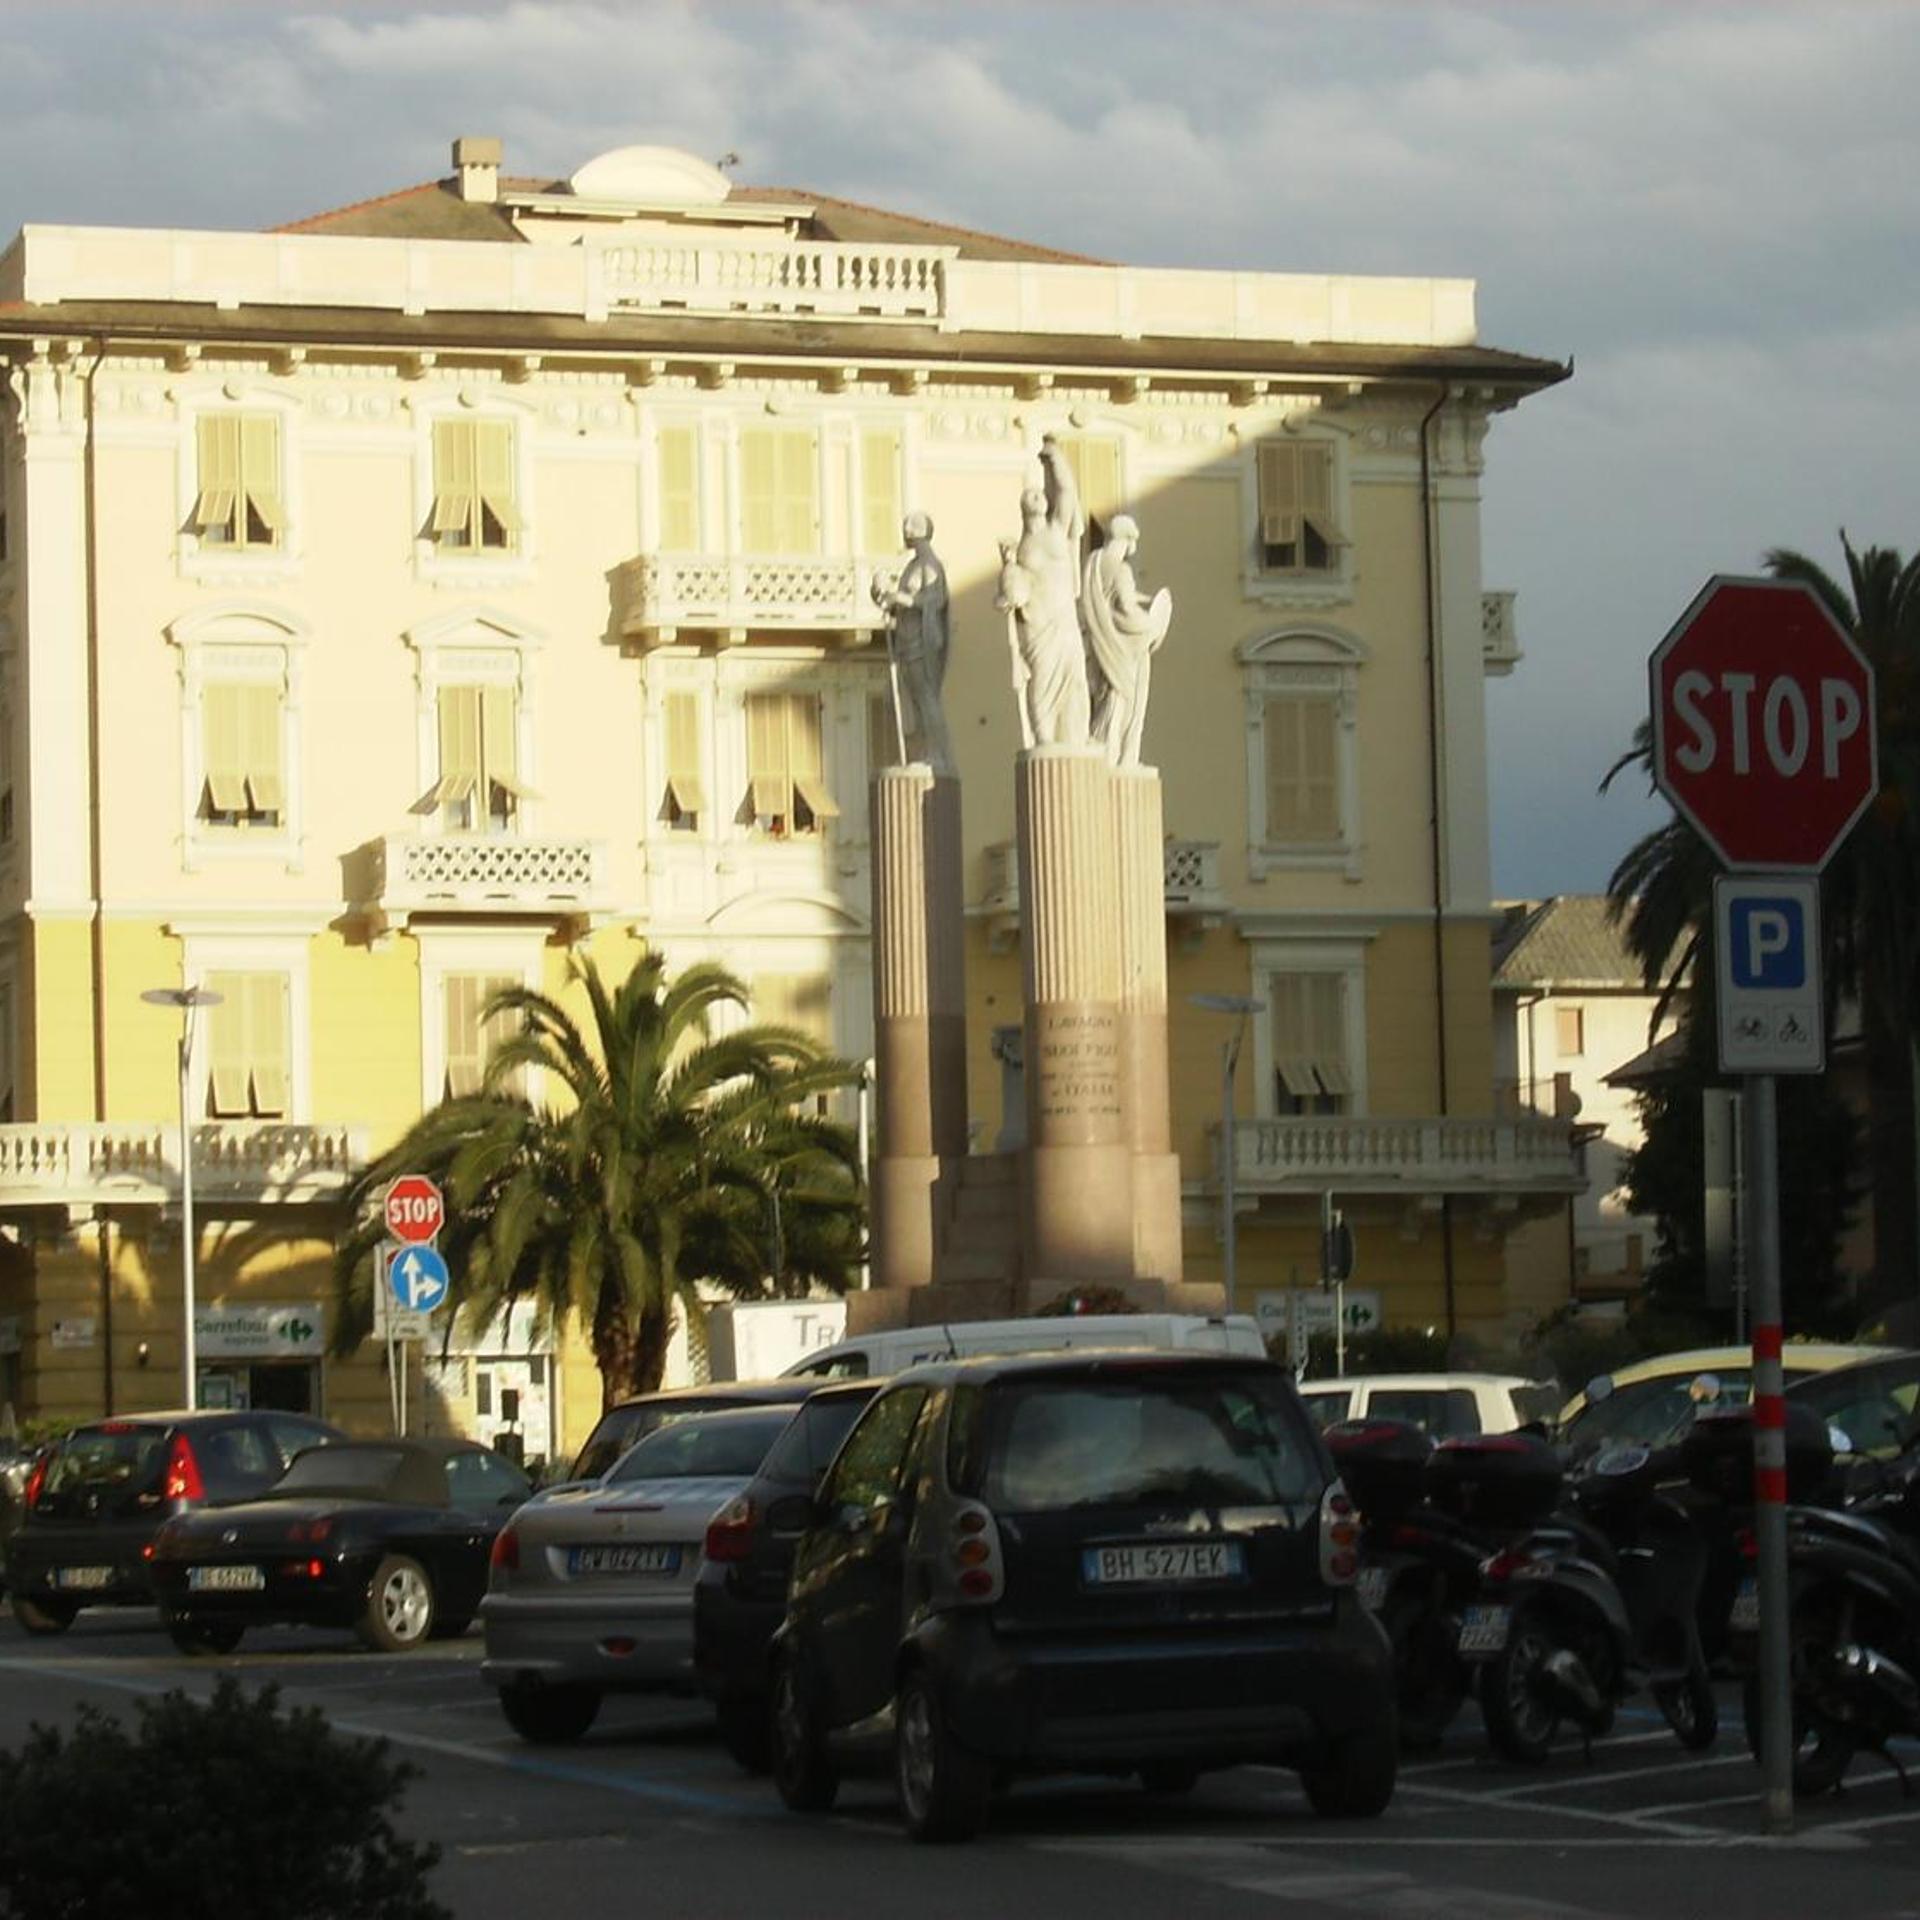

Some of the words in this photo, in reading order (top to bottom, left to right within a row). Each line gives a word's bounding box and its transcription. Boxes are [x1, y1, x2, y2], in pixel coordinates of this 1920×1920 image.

[1671, 669, 1862, 780] STOP
[1747, 910, 1790, 977] P
[389, 1197, 438, 1224] STOP
[1102, 1550, 1135, 1579] BH
